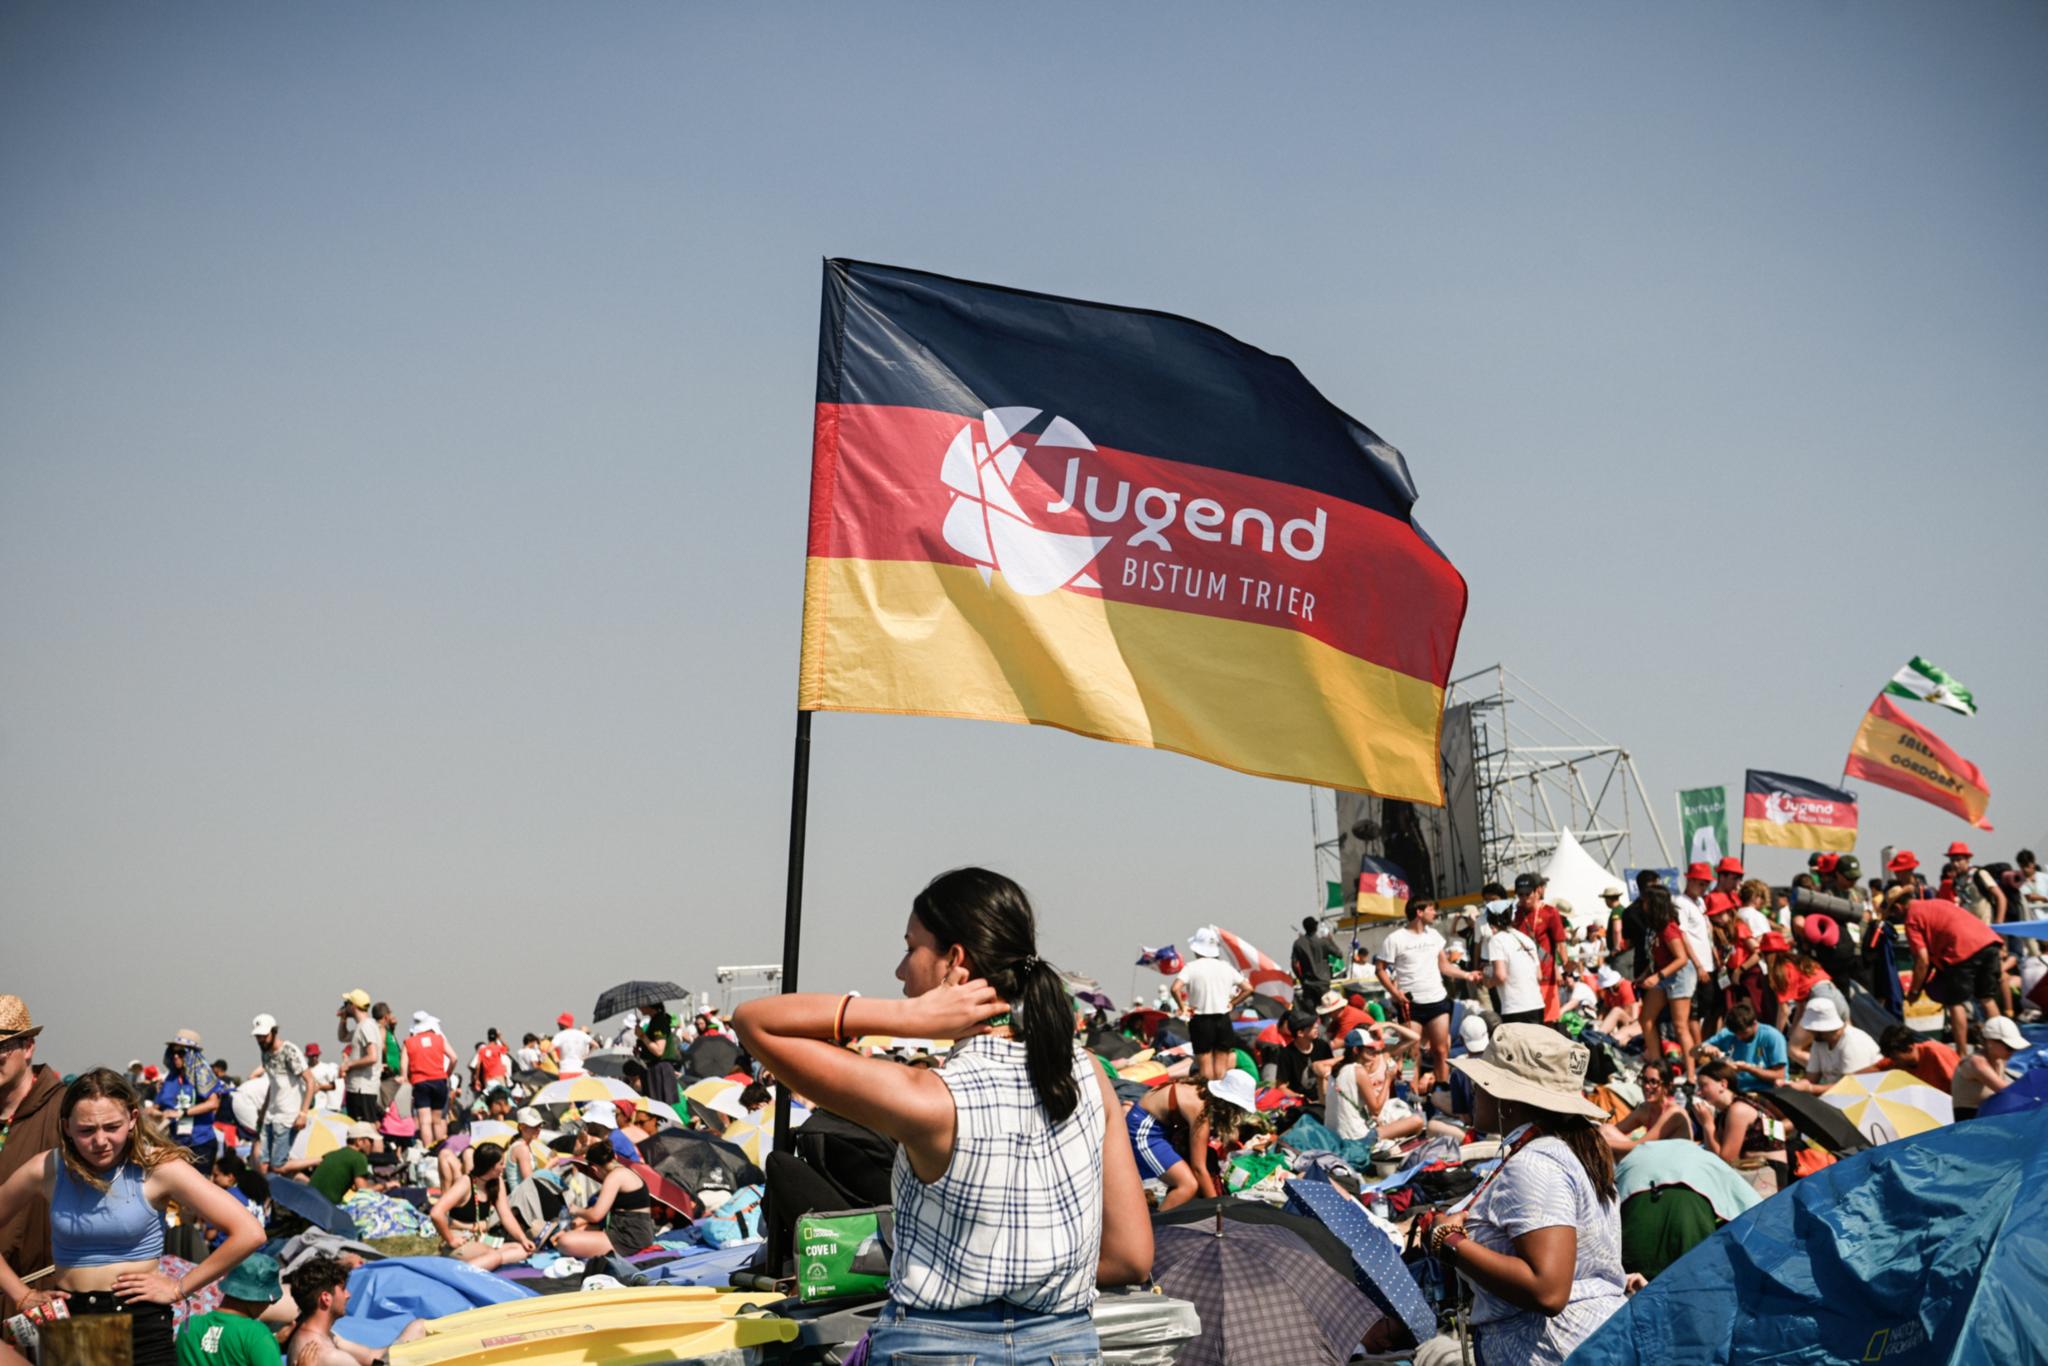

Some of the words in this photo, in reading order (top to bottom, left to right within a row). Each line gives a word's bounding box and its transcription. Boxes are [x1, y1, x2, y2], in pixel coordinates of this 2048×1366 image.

[1047, 457, 1327, 561] Jugend
[1122, 558, 1227, 601] BISTUM
[1239, 577, 1316, 622] TRIER
[1784, 800, 1833, 816] Jugend
[805, 1244, 829, 1256] COVE
